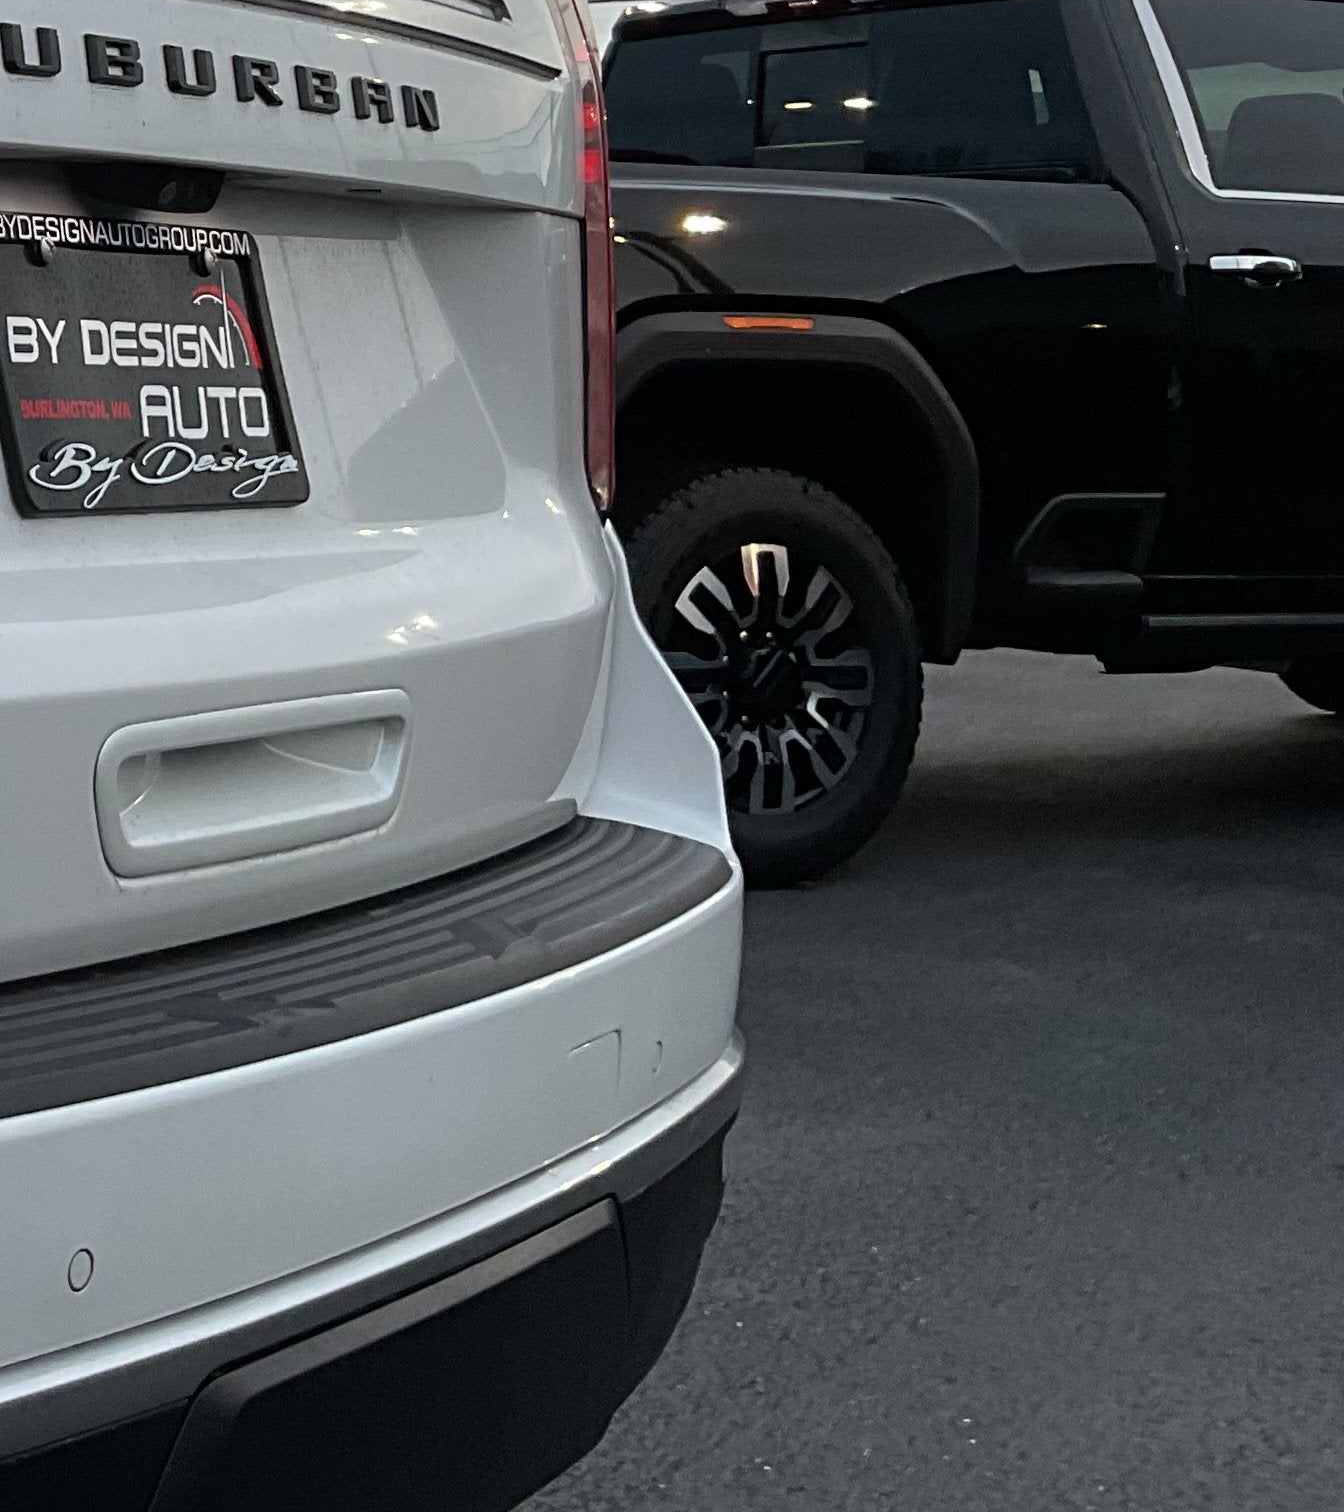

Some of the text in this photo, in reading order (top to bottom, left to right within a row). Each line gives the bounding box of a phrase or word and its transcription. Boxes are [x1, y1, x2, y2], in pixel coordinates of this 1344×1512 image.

[6, 316, 235, 369] BY DESIGN
[111, 400, 132, 420] WA
[139, 384, 270, 439] AUTO
[29, 441, 299, 509] By Design
